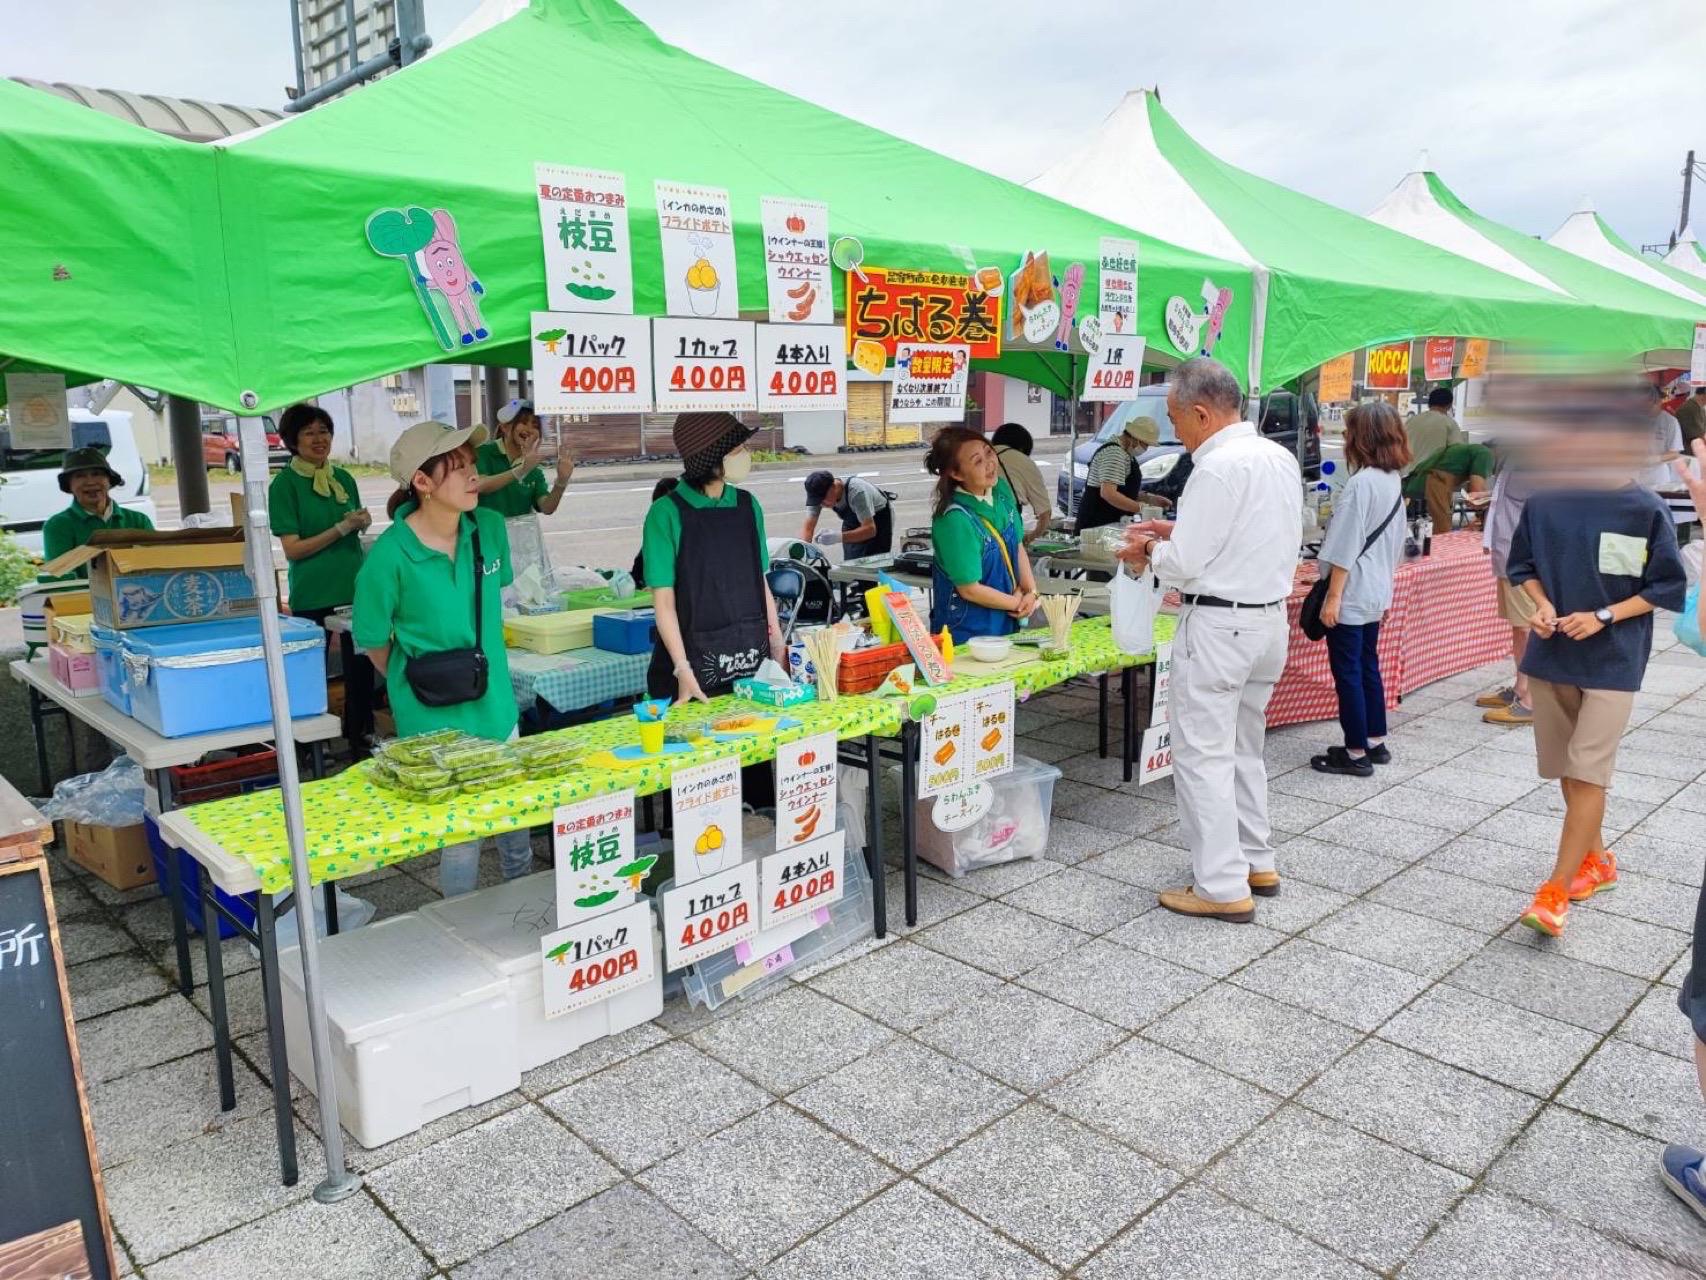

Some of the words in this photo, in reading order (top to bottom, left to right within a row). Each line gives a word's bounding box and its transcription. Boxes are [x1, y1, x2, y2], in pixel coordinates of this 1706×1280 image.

[539, 184, 625, 206] 夏の定番おつまみ
[557, 216, 616, 252] 枝豆
[662, 215, 729, 232] フライドポテト
[778, 265, 821, 279] ウインナー
[856, 286, 998, 343] ちはる巻
[566, 332, 626, 356] 1パック
[679, 337, 738, 357] 1カップ
[776, 344, 830, 362] 4本入り
[1107, 348, 1124, 363] 1杯
[911, 356, 953, 374] 数量限定
[1369, 350, 1409, 374] ROCCA
[560, 365, 636, 392] 400円
[670, 365, 746, 391] 400円
[769, 371, 837, 394] 400円
[1093, 370, 1134, 387] 400円
[675, 783, 738, 810] フライドポテト
[788, 792, 828, 811] ウインナー
[556, 806, 632, 836] 夏の定番おつまみ
[569, 833, 622, 872] 枝豆
[780, 852, 830, 880] 4本入り
[687, 883, 742, 917] 1カップ
[773, 869, 835, 911] 400円
[680, 901, 749, 946] 400円
[572, 926, 629, 960] 1パック
[569, 948, 638, 991] 400円
